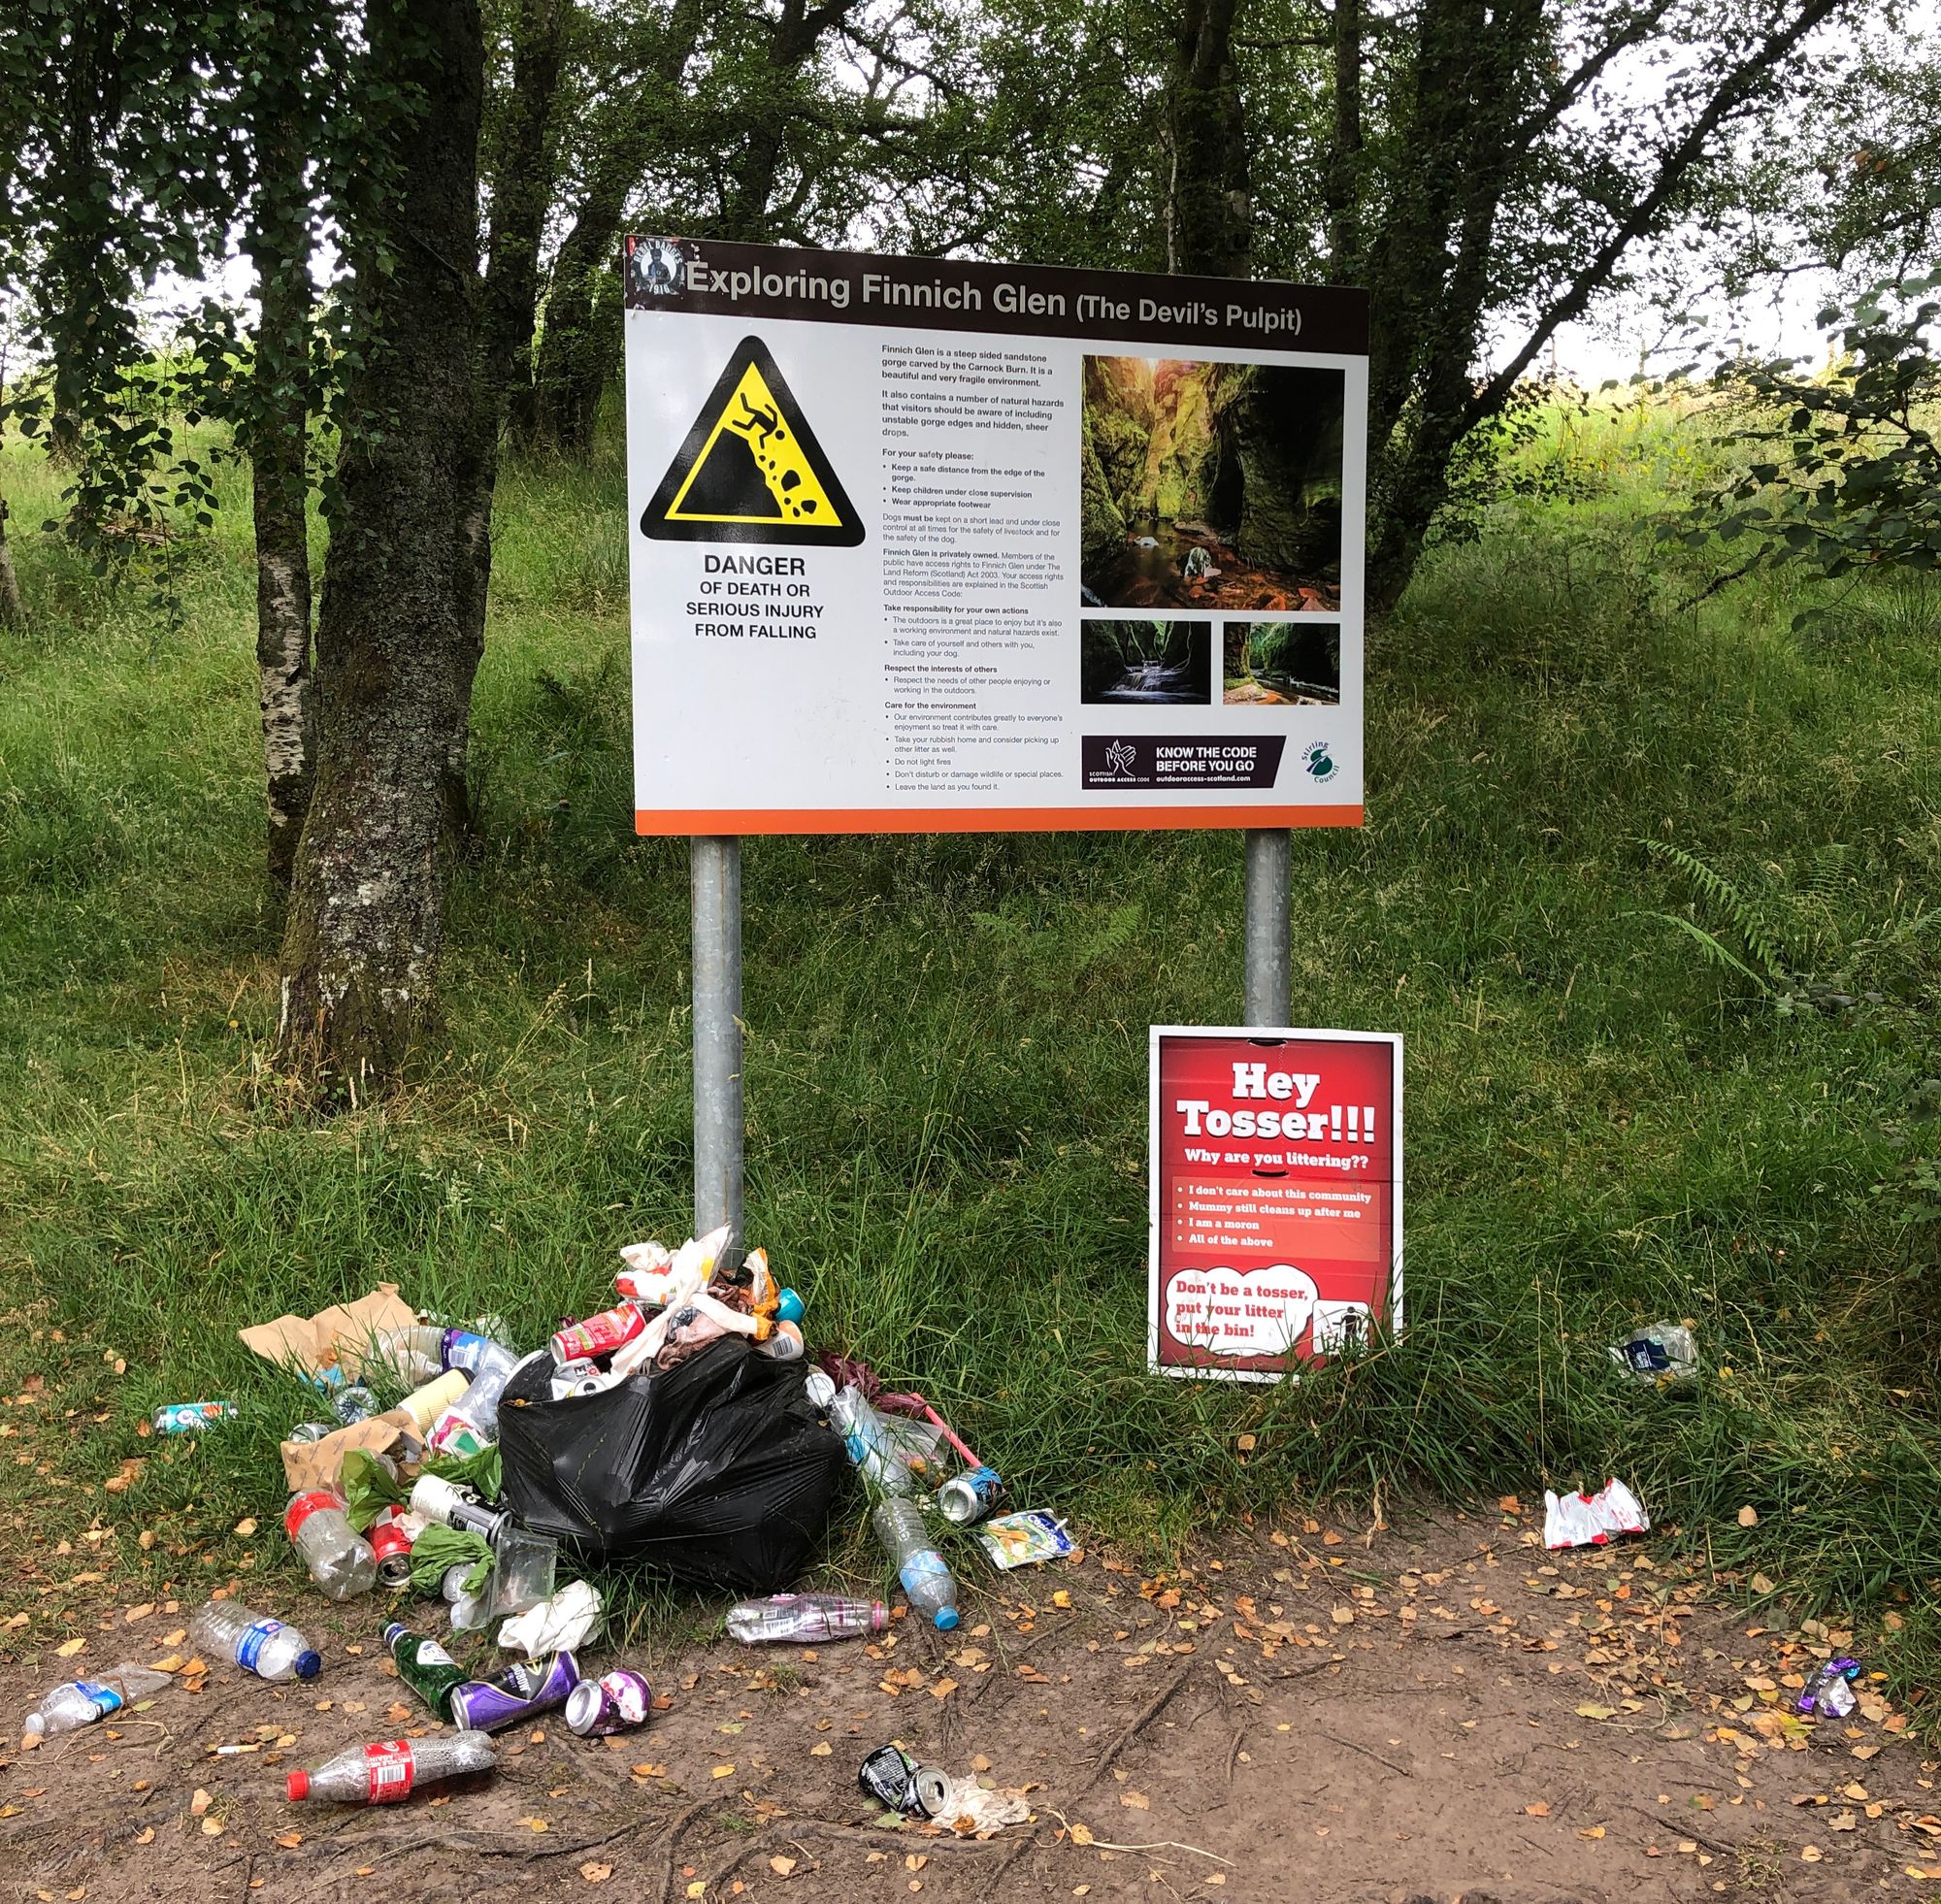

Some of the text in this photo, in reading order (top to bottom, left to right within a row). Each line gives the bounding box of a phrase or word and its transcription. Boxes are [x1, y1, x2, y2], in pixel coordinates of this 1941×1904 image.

[634, 241, 683, 264] REBEL BADGES
[687, 260, 1301, 336] Exploring Finnich Glen (The Devil's Pulpit)
[882, 345, 912, 354] Finnich
[915, 346, 935, 355] Glen
[938, 347, 943, 356] is
[954, 350, 976, 359] steep
[1004, 353, 1046, 362] sandstone
[882, 359, 906, 368] gorge
[940, 361, 950, 371] by
[969, 363, 1003, 373] Carnock
[1006, 365, 1028, 374] Burn.
[1031, 366, 1036, 375] It
[882, 371, 919, 379] beautiful
[959, 375, 985, 385] fragile
[988, 378, 1040, 387] environment.
[891, 390, 908, 399] also
[1032, 398, 1064, 407] hazards
[902, 404, 932, 412] visitors
[935, 406, 962, 414] should
[965, 407, 974, 415] be
[1015, 410, 1052, 420] including
[882, 416, 918, 425] unstable
[947, 419, 972, 429] edges
[993, 420, 1023, 431] hidden,
[882, 428, 908, 438] drops.
[919, 450, 943, 460] safety
[945, 451, 973, 460] please:
[892, 485, 911, 495] Keep
[990, 490, 1032, 499] supervision
[705, 555, 805, 576] DANGER
[700, 581, 809, 597] OF DEATH OR
[883, 586, 912, 596] Outdoor
[686, 602, 824, 618] SERIOUS INJURY
[904, 606, 952, 614] responsibility
[695, 624, 816, 639] FROM FALLING
[1157, 747, 1257, 758] KNOW THE CODE
[1301, 740, 1329, 761] Stirling
[1157, 760, 1254, 771] BEFORE YOU GO
[1314, 765, 1340, 783] Council
[1233, 1063, 1320, 1108] Hey
[1176, 1100, 1374, 1142] Tosser!!!
[1184, 1148, 1368, 1170] Why are you littering??
[1189, 1185, 1194, 1195] I
[1196, 1185, 1223, 1196] don't
[1252, 1188, 1283, 1198] about
[1285, 1189, 1306, 1199] this
[1308, 1192, 1371, 1204] community
[1189, 1201, 1233, 1214] Mummy
[1235, 1203, 1257, 1213] still
[1260, 1204, 1295, 1215] cleans
[1298, 1208, 1312, 1218] up
[1314, 1207, 1341, 1217] after
[1189, 1218, 1194, 1227] I
[1224, 1221, 1260, 1230] moron
[1189, 1233, 1273, 1247] All of the above
[1176, 1280, 1308, 1301] Don't be a tosser,
[1176, 1303, 1284, 1318] put your litter
[1176, 1321, 1254, 1337] in the bin!
